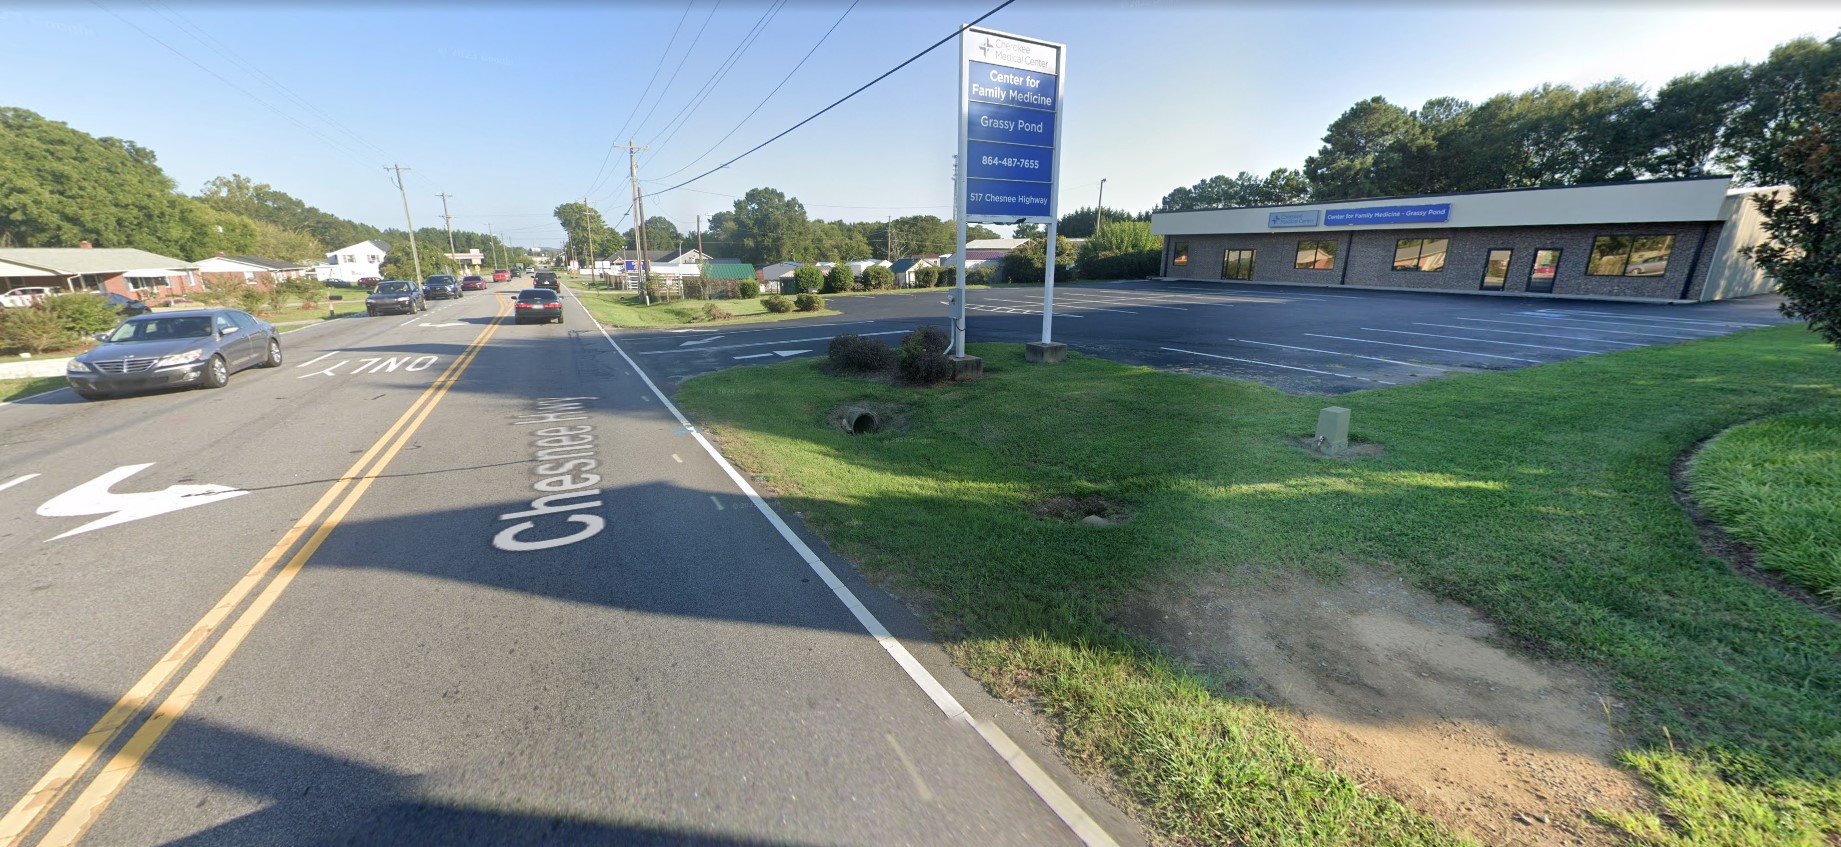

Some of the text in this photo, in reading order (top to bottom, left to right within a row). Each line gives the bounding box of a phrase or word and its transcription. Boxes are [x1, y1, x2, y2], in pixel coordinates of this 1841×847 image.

[995, 39, 1031, 54] Cherokee
[995, 51, 1048, 68] Medical Center
[989, 70, 1040, 88] Center for
[972, 85, 1052, 106] Family Medicine
[980, 115, 1043, 133] Grassy Pond
[981, 156, 1040, 169] 864-487-7655
[970, 193, 1048, 205] 517 Chesnee Highway
[296, 351, 439, 379] ONLY
